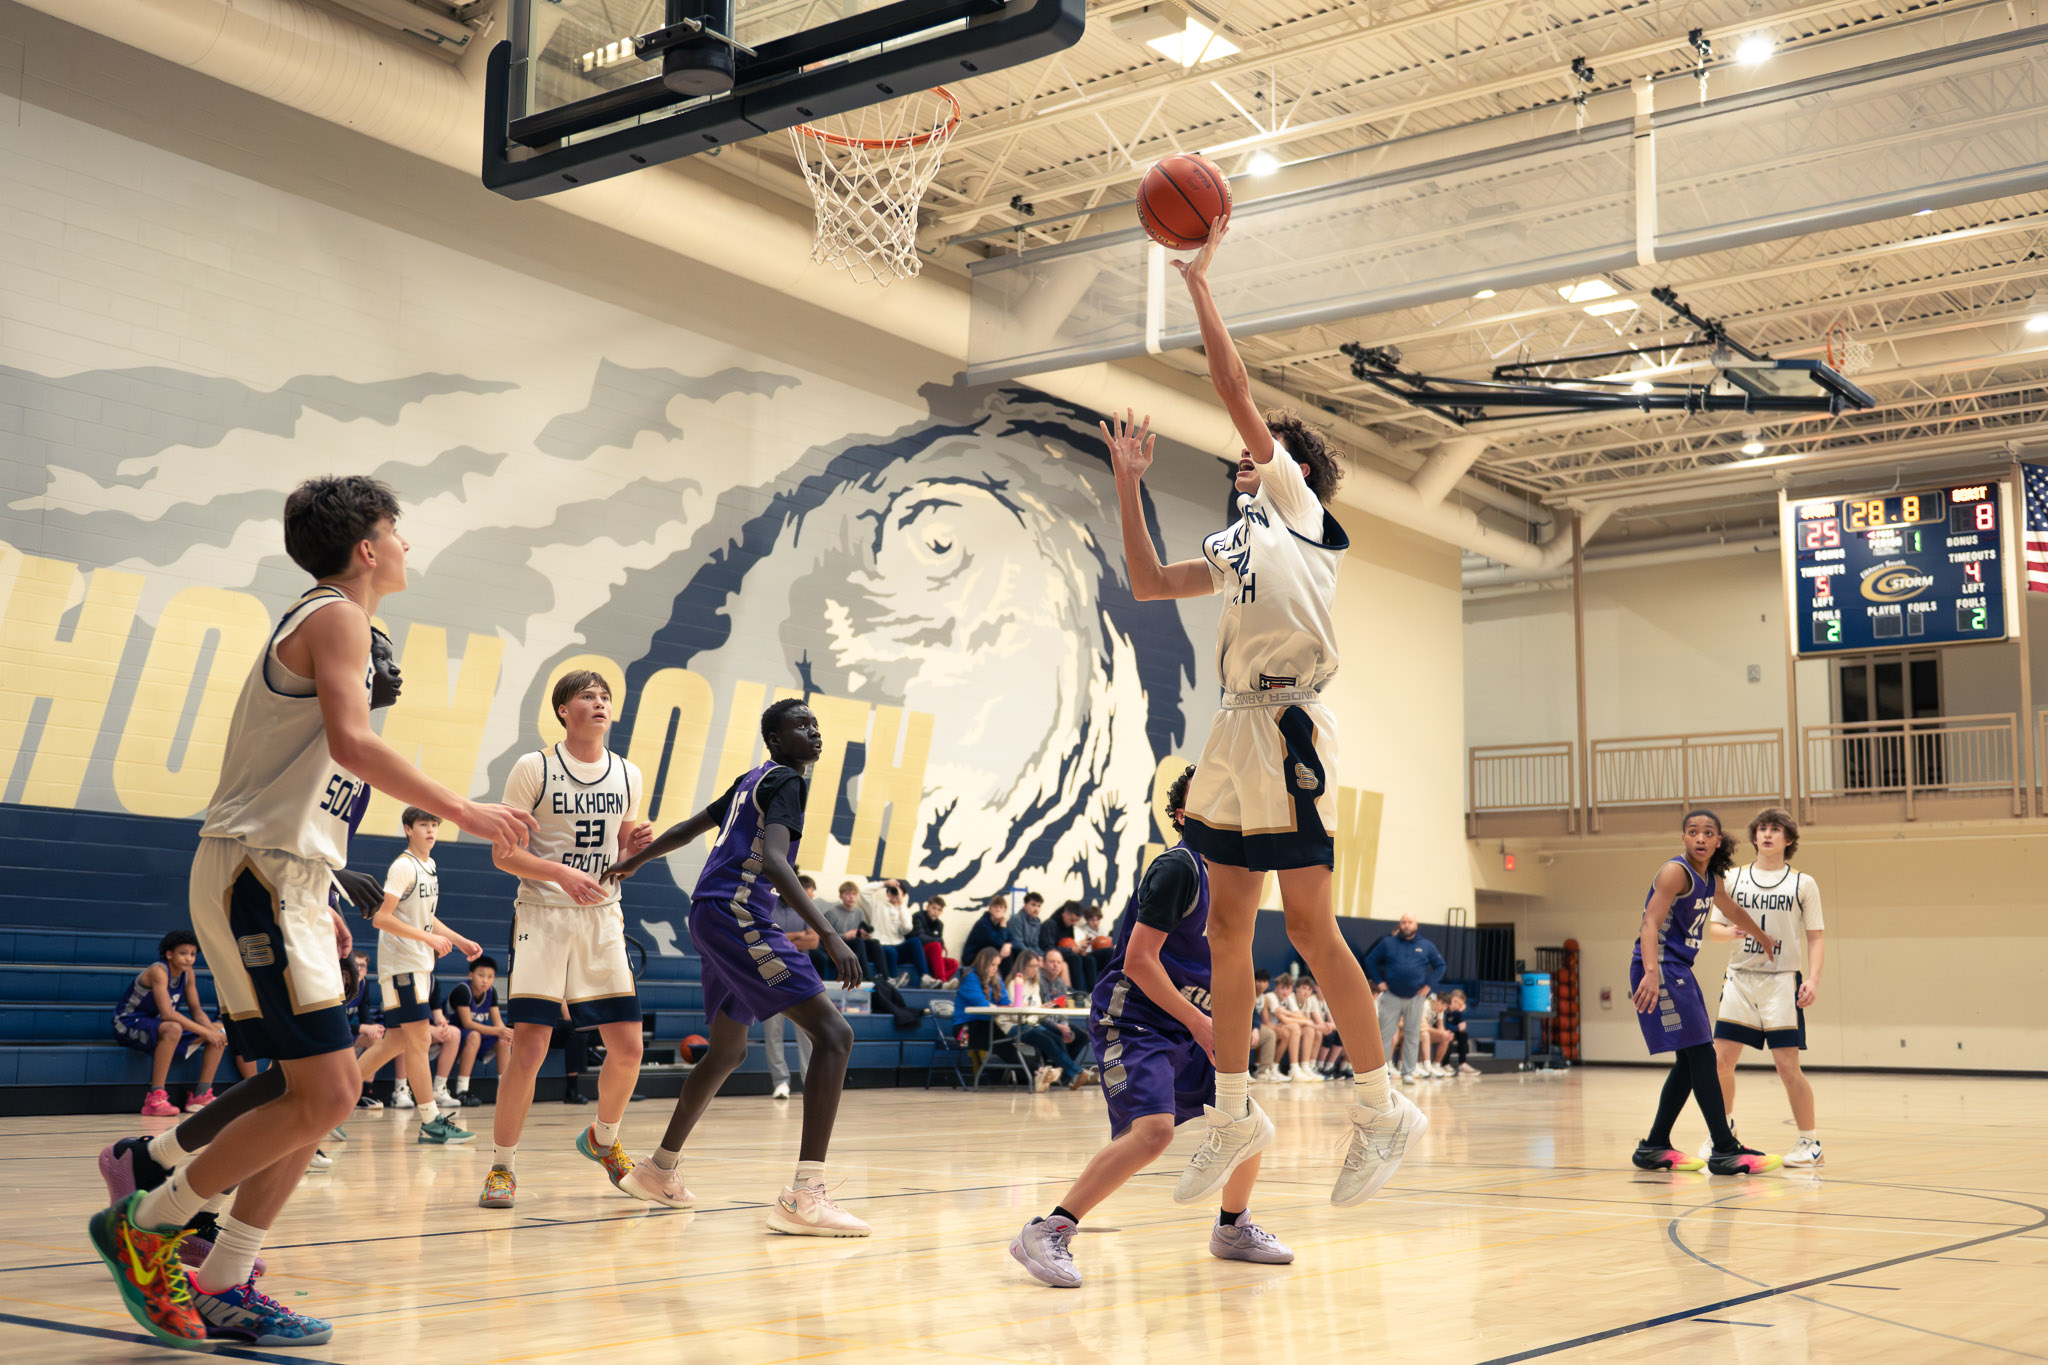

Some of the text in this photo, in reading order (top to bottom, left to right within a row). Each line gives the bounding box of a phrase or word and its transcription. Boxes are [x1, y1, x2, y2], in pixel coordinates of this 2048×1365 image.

[1975, 503, 1994, 530] 8
[1806, 520, 1840, 548] 25
[1868, 536, 1903, 549] PERIOD
[1914, 531, 1921, 552] 1
[1946, 535, 1978, 547] BONUS
[1814, 548, 1845, 561] BONUS
[1948, 550, 1996, 563] TIMEOUTS
[1800, 564, 1846, 578] TIMEOUTS
[1965, 561, 1980, 582] 4
[1816, 575, 1830, 597] 5
[1891, 575, 1934, 589] STORM
[1962, 582, 1985, 594] LEFT
[1812, 595, 1834, 608] LEFT
[1867, 601, 1937, 616] PLAYER FOULS
[1956, 597, 1987, 609] FOULS
[1812, 609, 1841, 621] FOULS
[1971, 607, 1986, 630] 2
[1827, 620, 1841, 642] 2
[0, 549, 506, 842] HON
[553, 792, 623, 814] ELKHORN
[575, 819, 606, 848] 23
[562, 853, 610, 874] SOUTH
[1736, 892, 1793, 912] ELKHORN
[1761, 914, 1766, 932] 1
[1744, 938, 1782, 955] SOH
